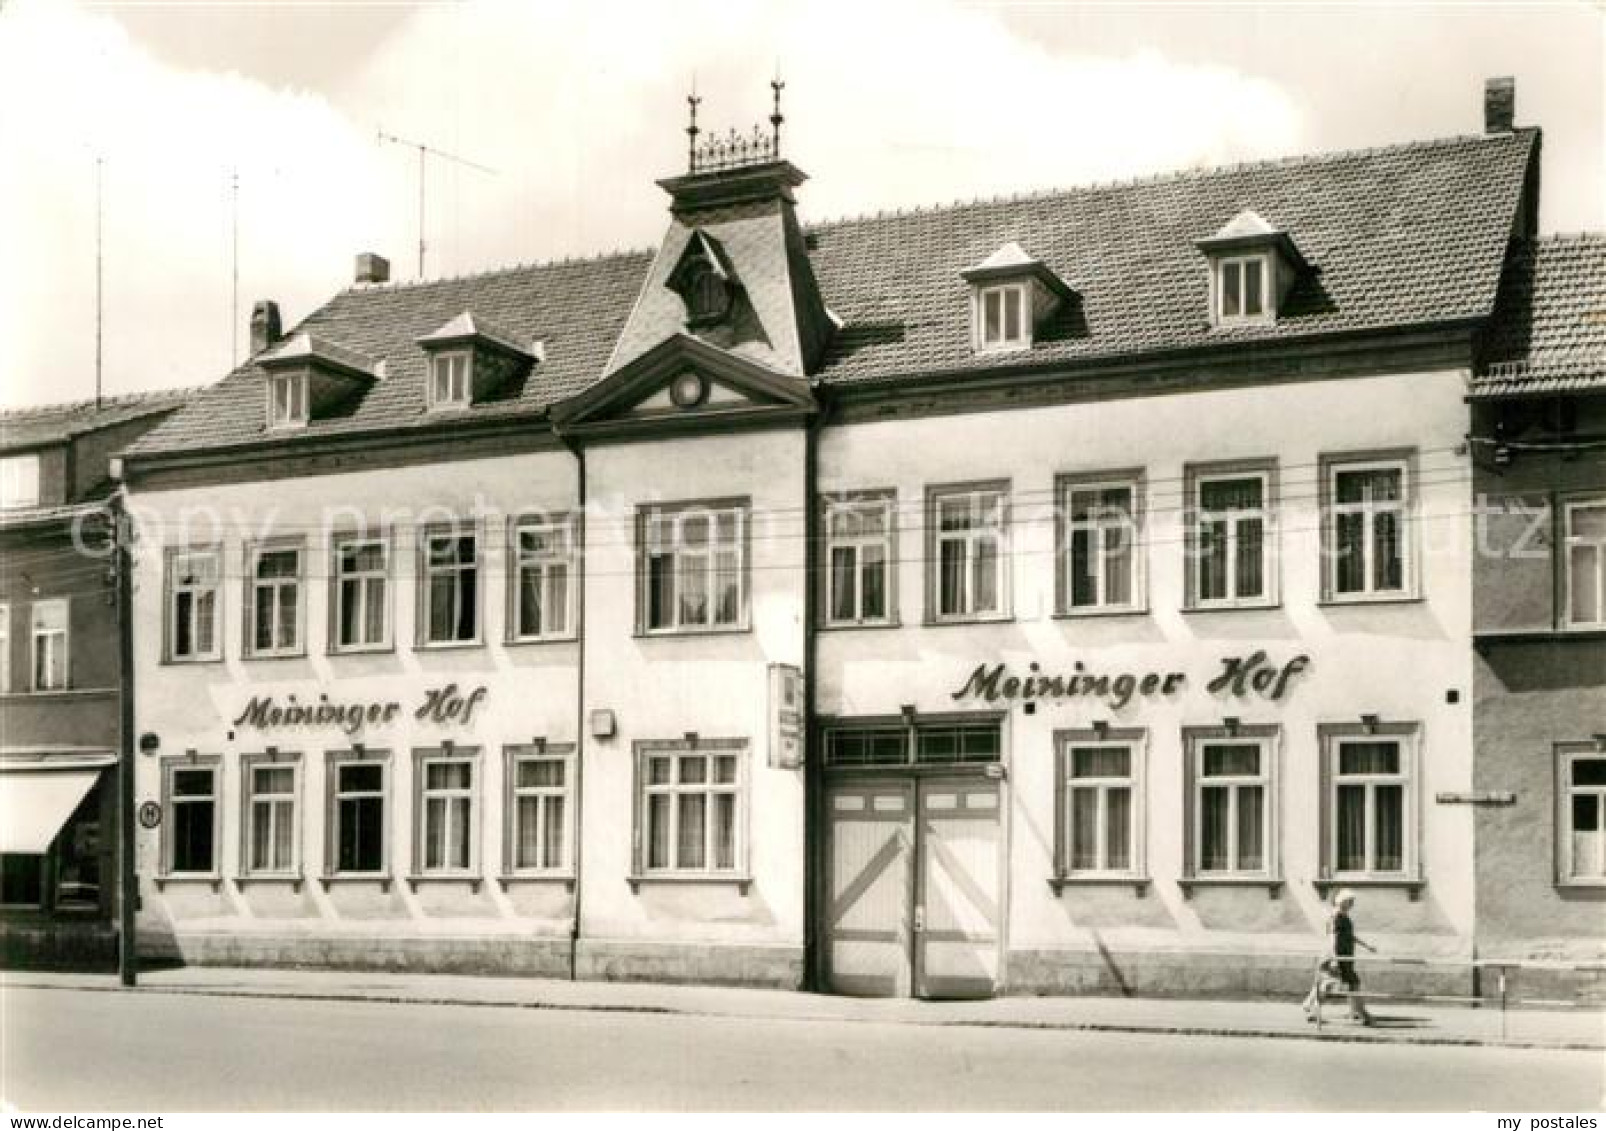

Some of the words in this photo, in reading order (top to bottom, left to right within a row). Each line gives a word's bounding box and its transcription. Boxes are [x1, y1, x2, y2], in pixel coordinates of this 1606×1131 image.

[952, 661, 1186, 711] Meininger
[1206, 650, 1311, 700] Hof
[234, 694, 400, 736] Meininger
[414, 684, 487, 724] Hof
